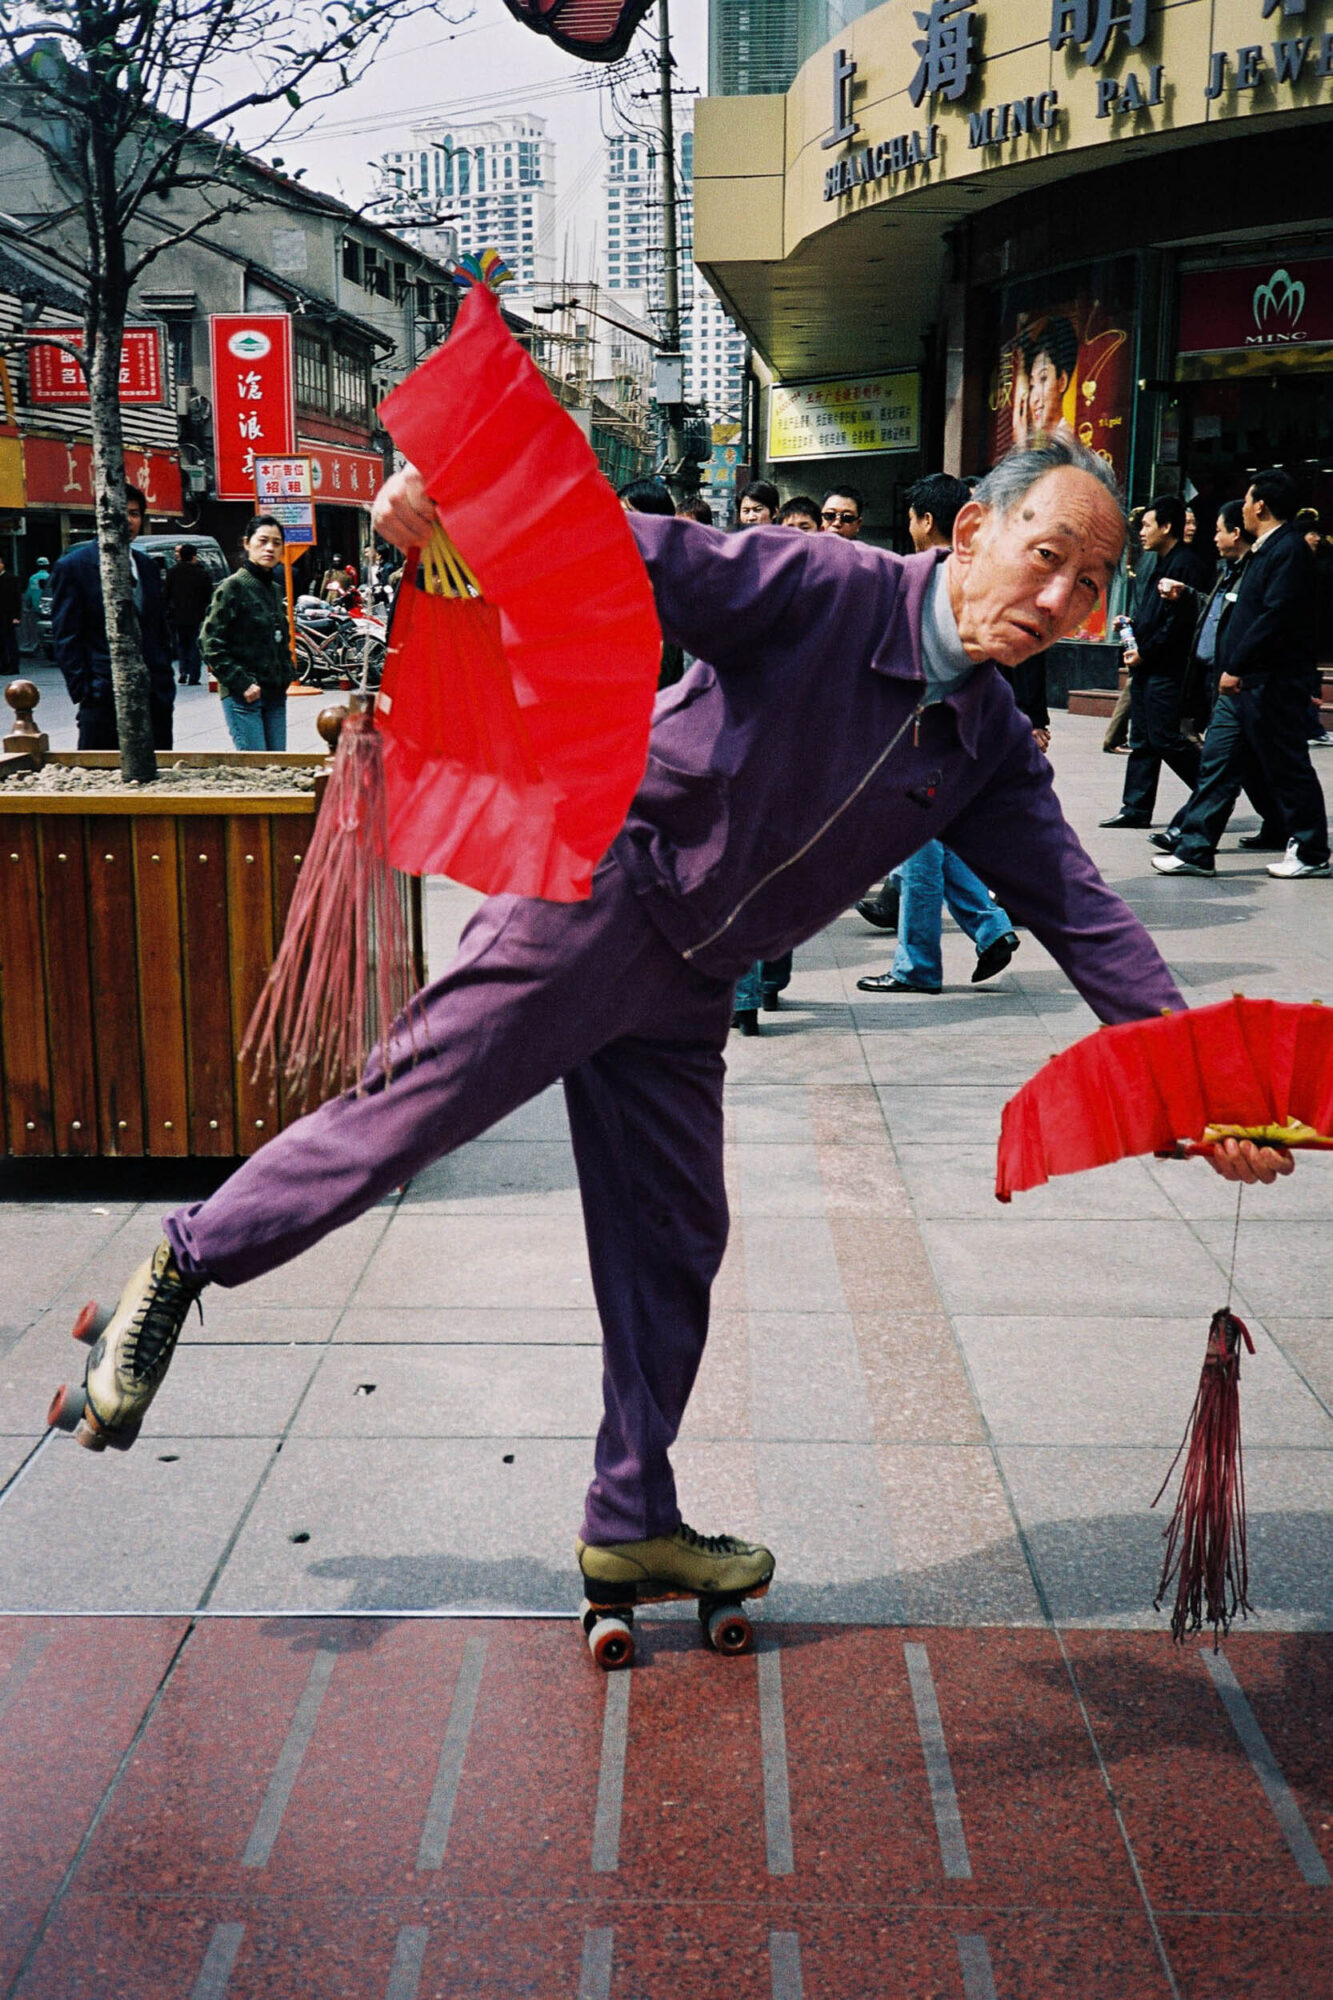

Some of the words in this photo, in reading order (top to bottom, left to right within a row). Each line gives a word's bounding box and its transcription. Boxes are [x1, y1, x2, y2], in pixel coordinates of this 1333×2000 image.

[824, 124, 939, 201] SHANGHAI
[967, 91, 1058, 149] MING
[1094, 65, 1164, 119] PAI
[261, 464, 304, 476] 本广告位
[266, 481, 302, 493] 招租
